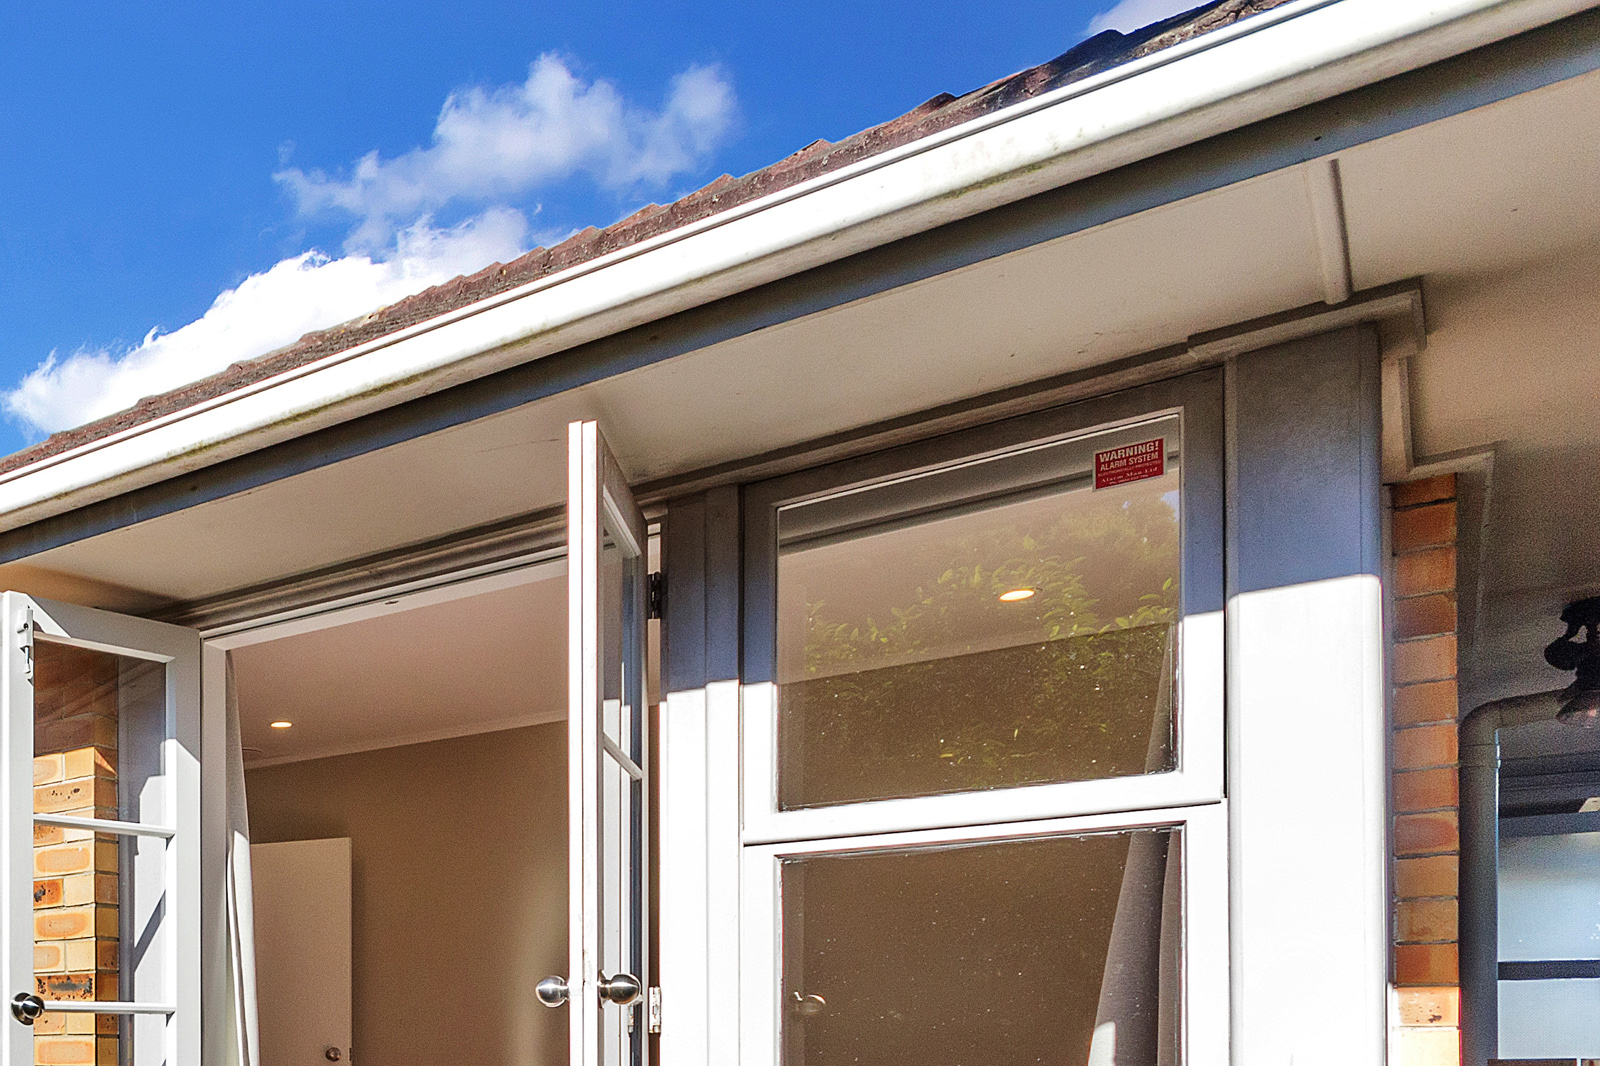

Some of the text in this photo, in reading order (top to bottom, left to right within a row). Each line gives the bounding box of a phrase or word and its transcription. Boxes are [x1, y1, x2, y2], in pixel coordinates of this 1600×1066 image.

[1099, 441, 1159, 463] WARNING!
[1100, 451, 1159, 472] ALARM SYSTEM
